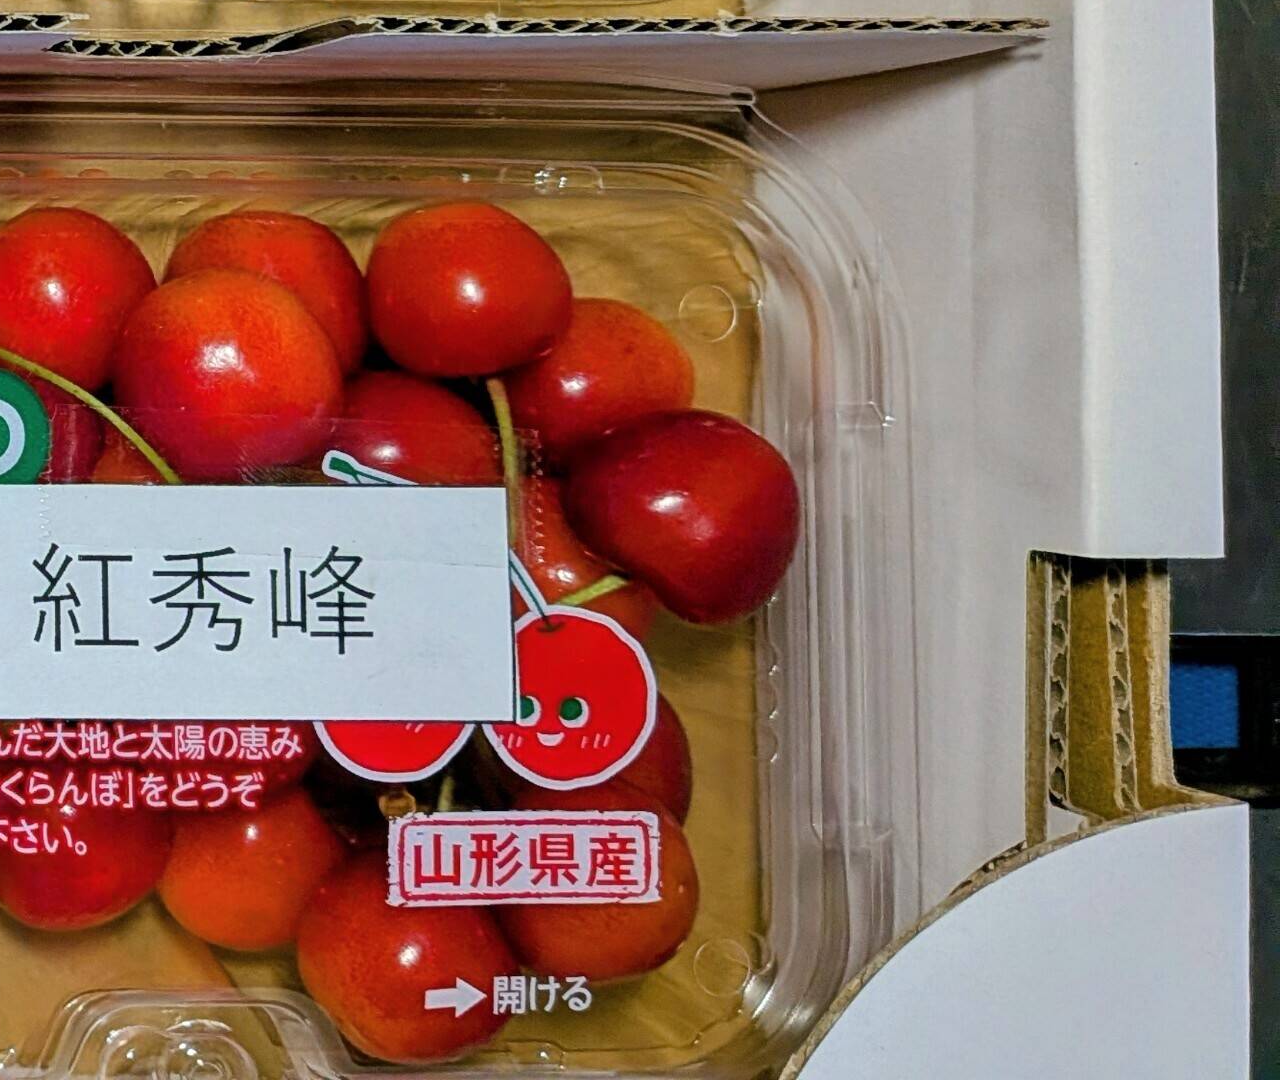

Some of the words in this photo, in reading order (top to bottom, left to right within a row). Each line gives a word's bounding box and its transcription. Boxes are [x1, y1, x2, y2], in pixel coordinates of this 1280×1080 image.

[32, 542, 377, 655] 紅秀峰
[413, 832, 638, 887] 山形県産
[493, 976, 592, 1014] 開ける
